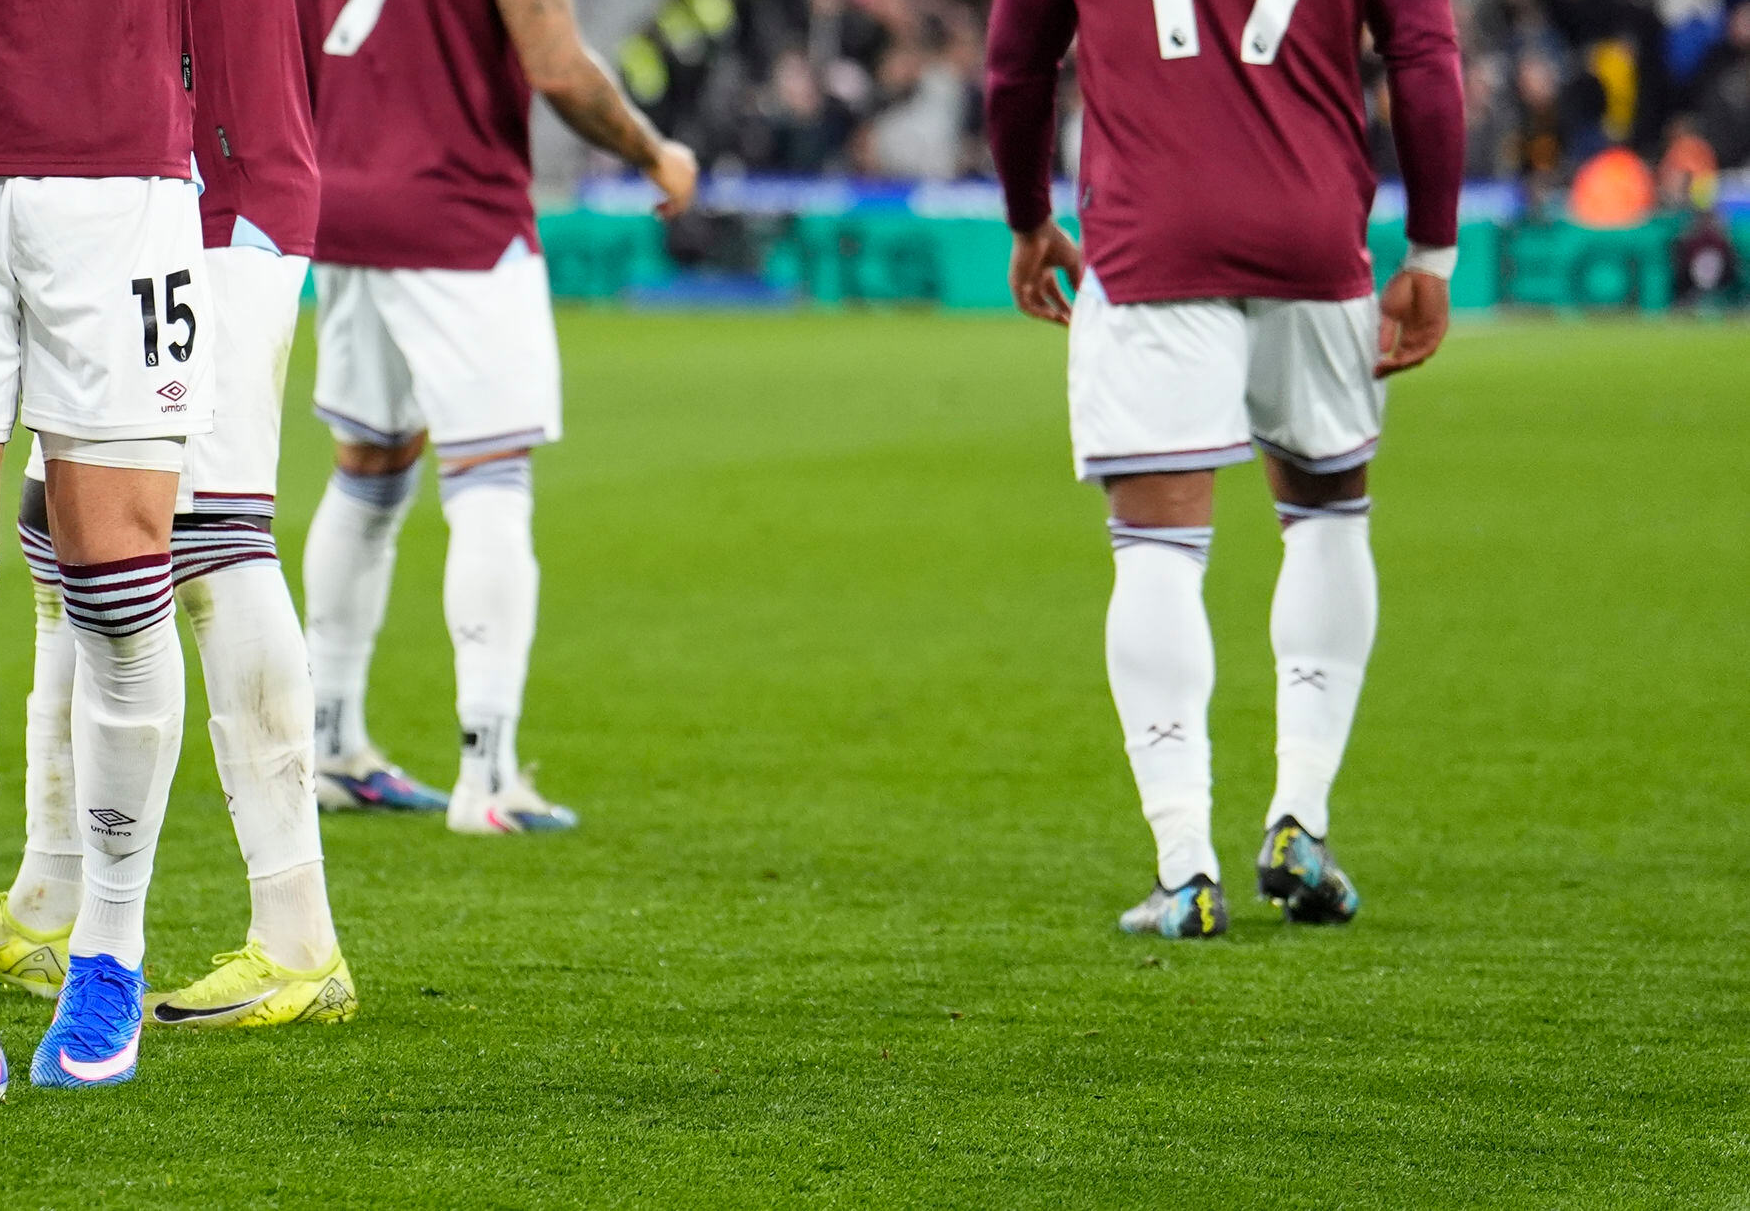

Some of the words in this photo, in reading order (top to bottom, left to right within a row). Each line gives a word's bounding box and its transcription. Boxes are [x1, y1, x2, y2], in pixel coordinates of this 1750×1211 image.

[131, 269, 196, 367] 15
[161, 403, 187, 413] umbro
[90, 824, 132, 837] umbro
